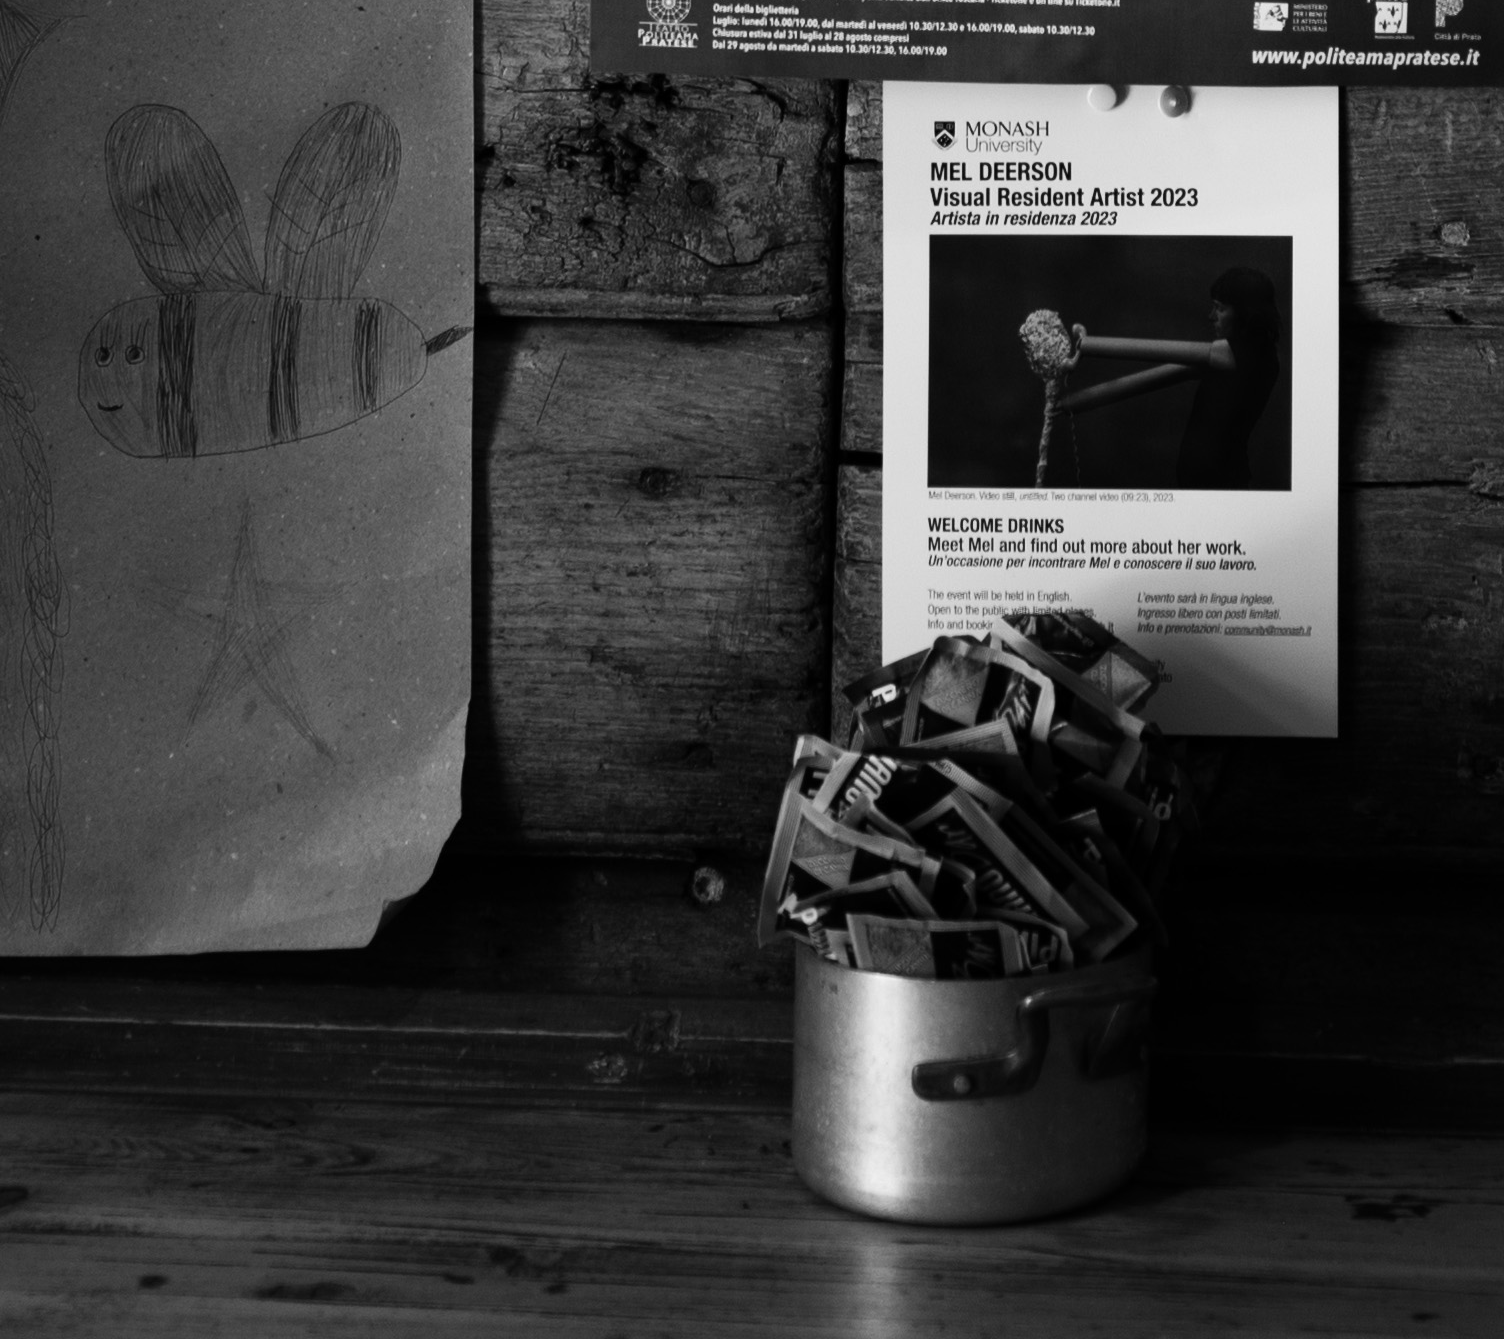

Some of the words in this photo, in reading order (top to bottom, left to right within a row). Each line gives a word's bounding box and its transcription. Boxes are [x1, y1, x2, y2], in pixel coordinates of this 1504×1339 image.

[1251, 46, 1481, 70] www.politeamapratese.it
[966, 120, 1049, 137] MONASH
[965, 138, 1043, 156] University
[930, 162, 973, 182] MEL
[979, 161, 1072, 182] DEERSON
[930, 187, 991, 207] Visual
[997, 186, 1085, 207] Resident
[1090, 187, 1145, 207] Artist
[1150, 187, 1199, 207] 2023
[930, 210, 981, 226] Artista
[985, 210, 1000, 226] in
[1003, 210, 1077, 226] residenza
[1080, 211, 1118, 226] 2023
[927, 517, 1003, 533] WELCOME
[1008, 518, 1065, 534] DRINKS
[928, 536, 964, 552] Meet
[968, 537, 994, 553] Mel
[999, 537, 1026, 553] and
[1030, 537, 1058, 554] find
[1062, 538, 1086, 554] out
[1090, 541, 1128, 554] more
[1131, 538, 1173, 555] about
[1177, 539, 1202, 555] her
[1205, 539, 1247, 556] work.
